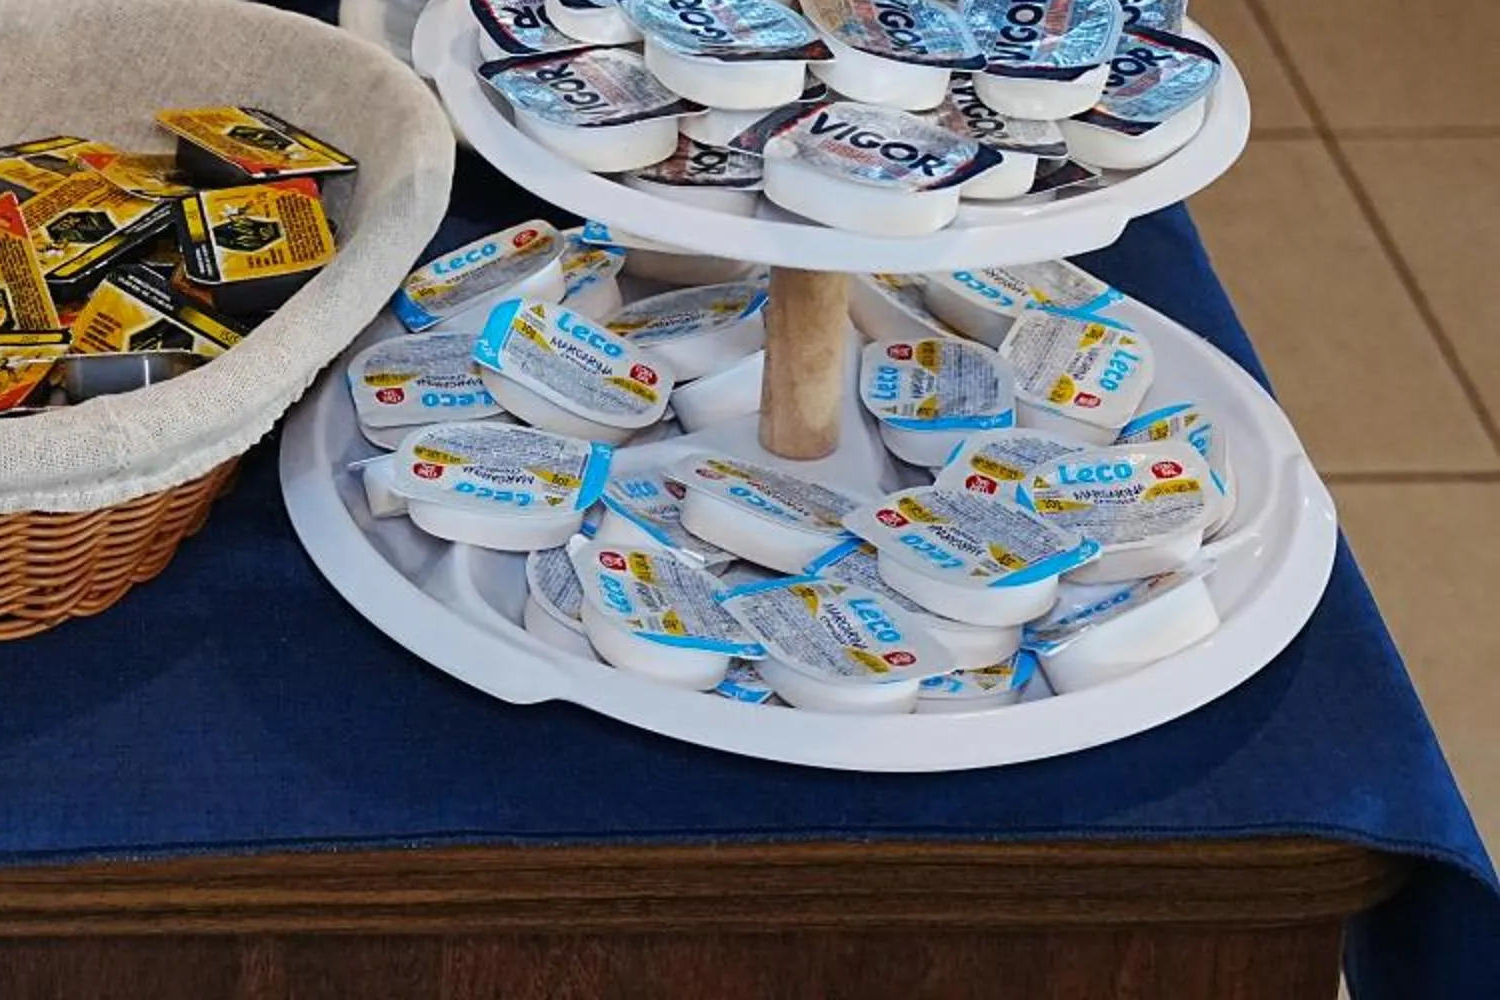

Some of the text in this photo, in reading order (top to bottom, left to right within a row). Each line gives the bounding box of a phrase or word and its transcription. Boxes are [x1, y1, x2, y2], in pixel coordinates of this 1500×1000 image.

[810, 111, 947, 177] VIGOR
[432, 243, 497, 276] Leco
[953, 270, 1013, 307] Leco
[556, 312, 624, 358] Leco
[872, 365, 898, 401] Leco
[1100, 349, 1140, 391] Leco
[1057, 461, 1133, 485] Leco
[454, 480, 534, 506] Leco
[898, 533, 965, 569] Leco
[849, 599, 901, 643] Leco
